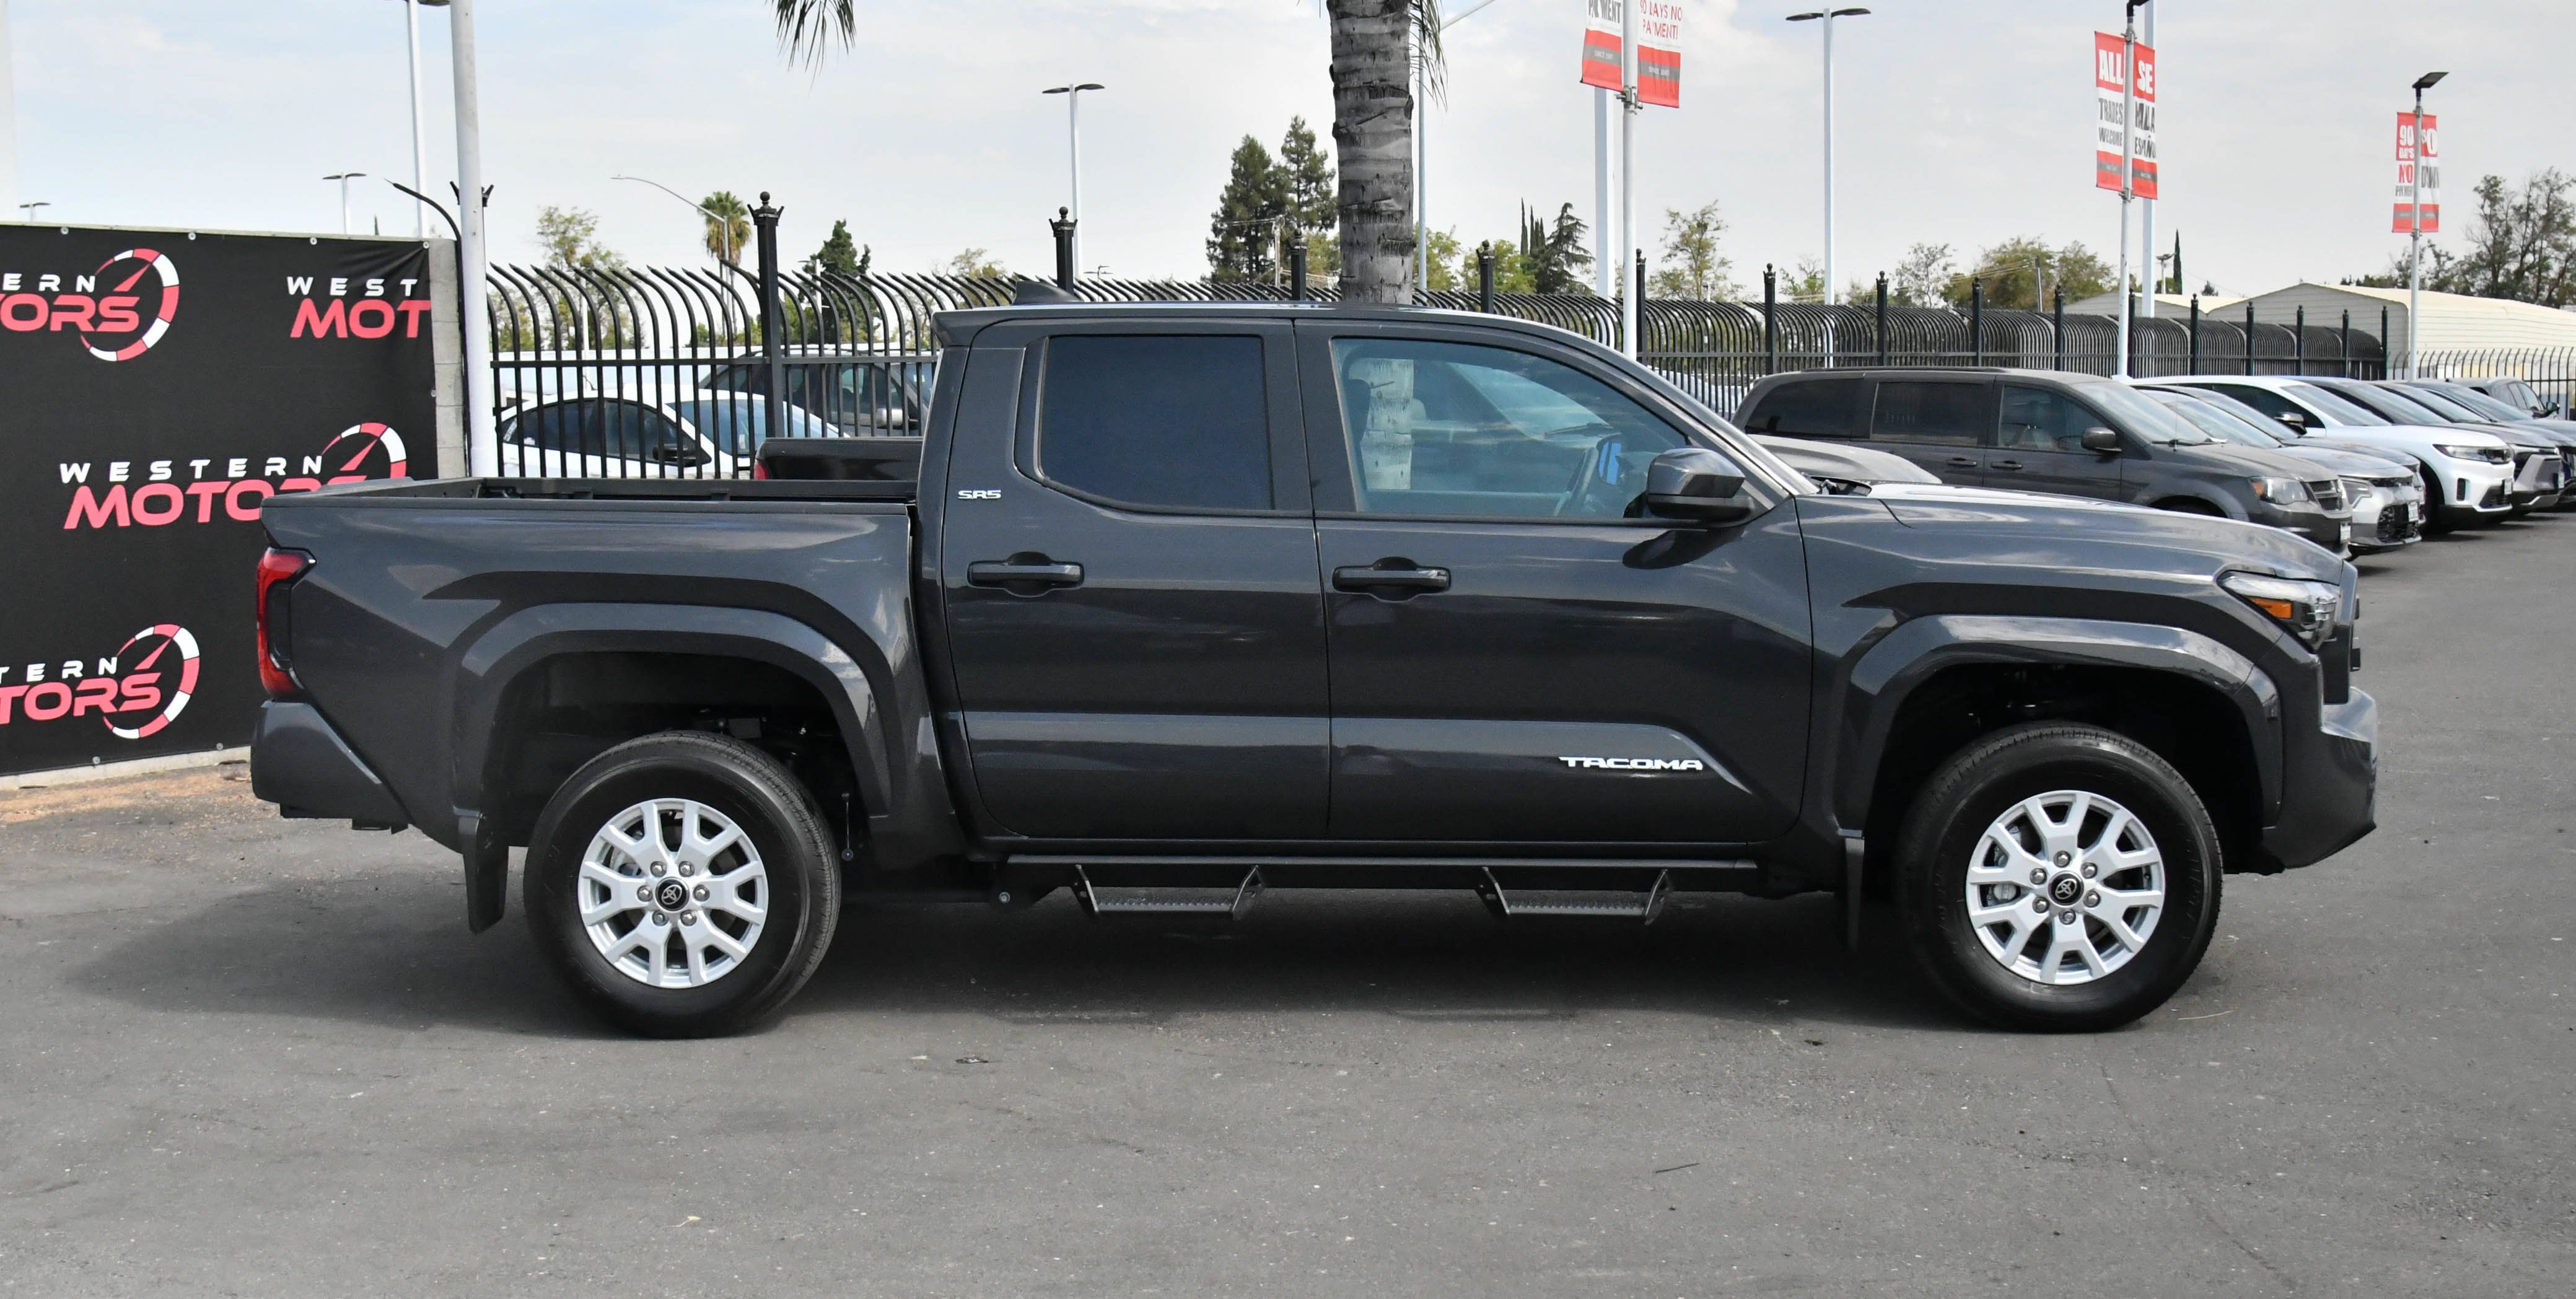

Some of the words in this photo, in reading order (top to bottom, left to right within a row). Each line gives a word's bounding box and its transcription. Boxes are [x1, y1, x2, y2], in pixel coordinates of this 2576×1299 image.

[1671, 6, 1682, 21] NO
[1642, 19, 1678, 40] PAMENT!
[2098, 50, 2124, 85] ALL
[2137, 60, 2153, 95] SE
[2098, 98, 2123, 125] TRADES
[2399, 125, 2414, 146] 90
[2399, 164, 2414, 183] NO
[2, 273, 95, 292] ERN
[287, 276, 418, 297] WEST
[0, 293, 140, 332] ORS
[290, 298, 431, 339] MOT
[60, 455, 322, 483] WESTERN
[64, 475, 367, 529] MOTO
[958, 489, 1002, 499] SR5
[1558, 756, 1703, 771] TACOMA
